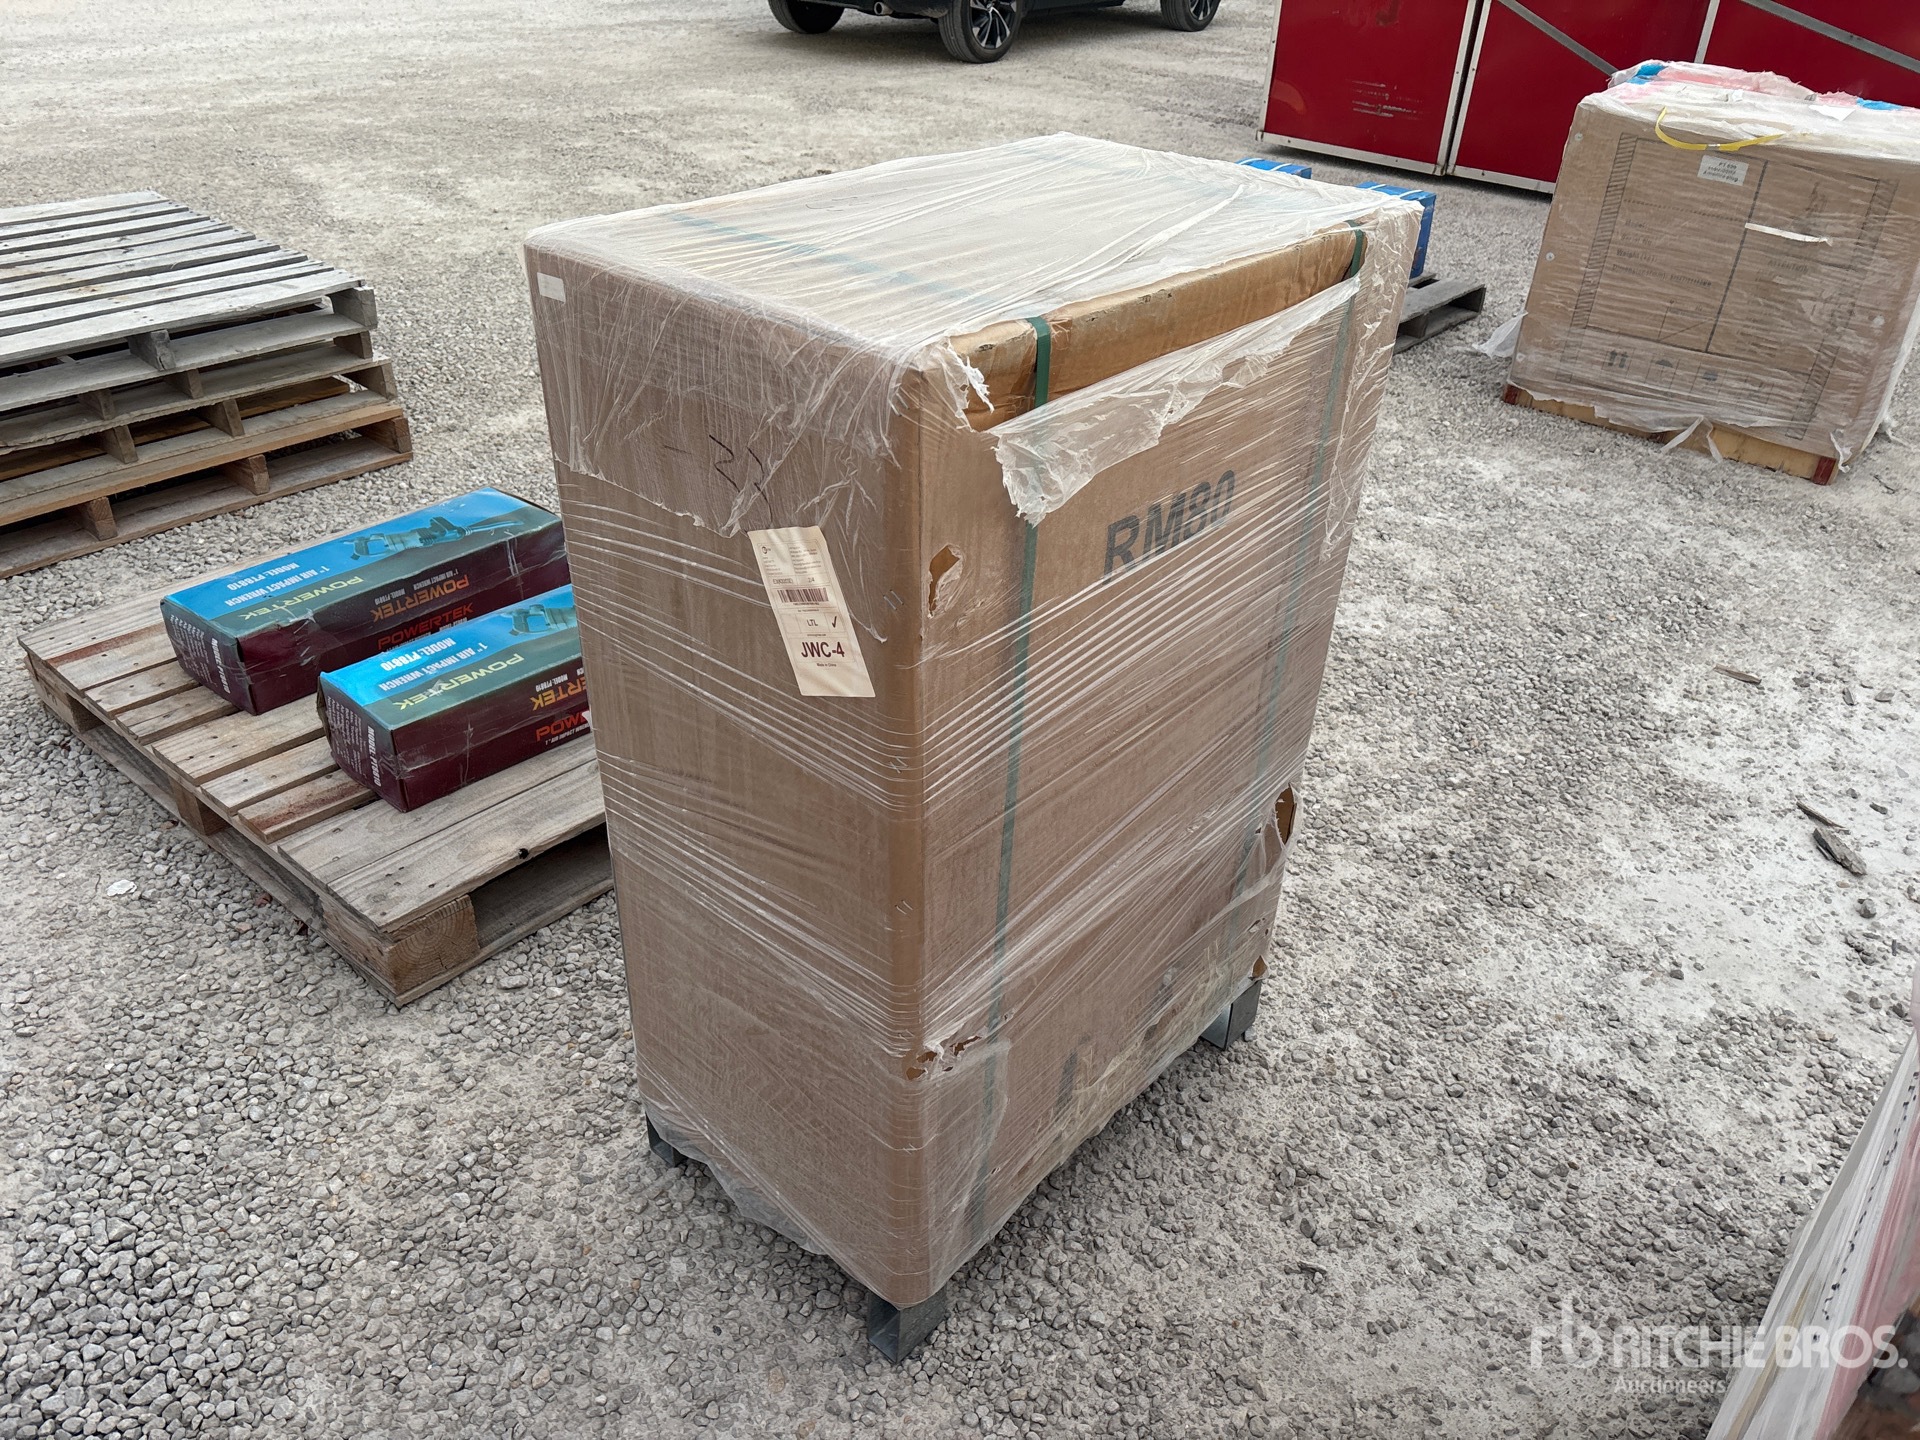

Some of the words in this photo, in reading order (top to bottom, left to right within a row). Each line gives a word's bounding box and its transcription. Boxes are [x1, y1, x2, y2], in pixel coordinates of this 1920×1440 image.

[1102, 470, 1236, 585] RM80
[262, 562, 300, 576] MODEL:
[299, 569, 318, 579] AIR
[227, 573, 266, 590] PT8810
[266, 575, 303, 592] IMPACT
[224, 588, 269, 607] WRENCH
[238, 576, 364, 620] POWERTEK
[370, 575, 470, 622] POWERTEK
[378, 602, 474, 650] POWERTEK
[417, 638, 456, 655] MODEL:
[456, 648, 476, 659] AIR
[801, 641, 845, 658] JWC-4
[380, 651, 422, 671] PT8810
[421, 655, 460, 674] IMPACT
[378, 670, 424, 691] WRENCH
[393, 654, 524, 710] POWERTEK
[368, 725, 376, 755] MODEL:
[370, 756, 381, 786] PT8810
